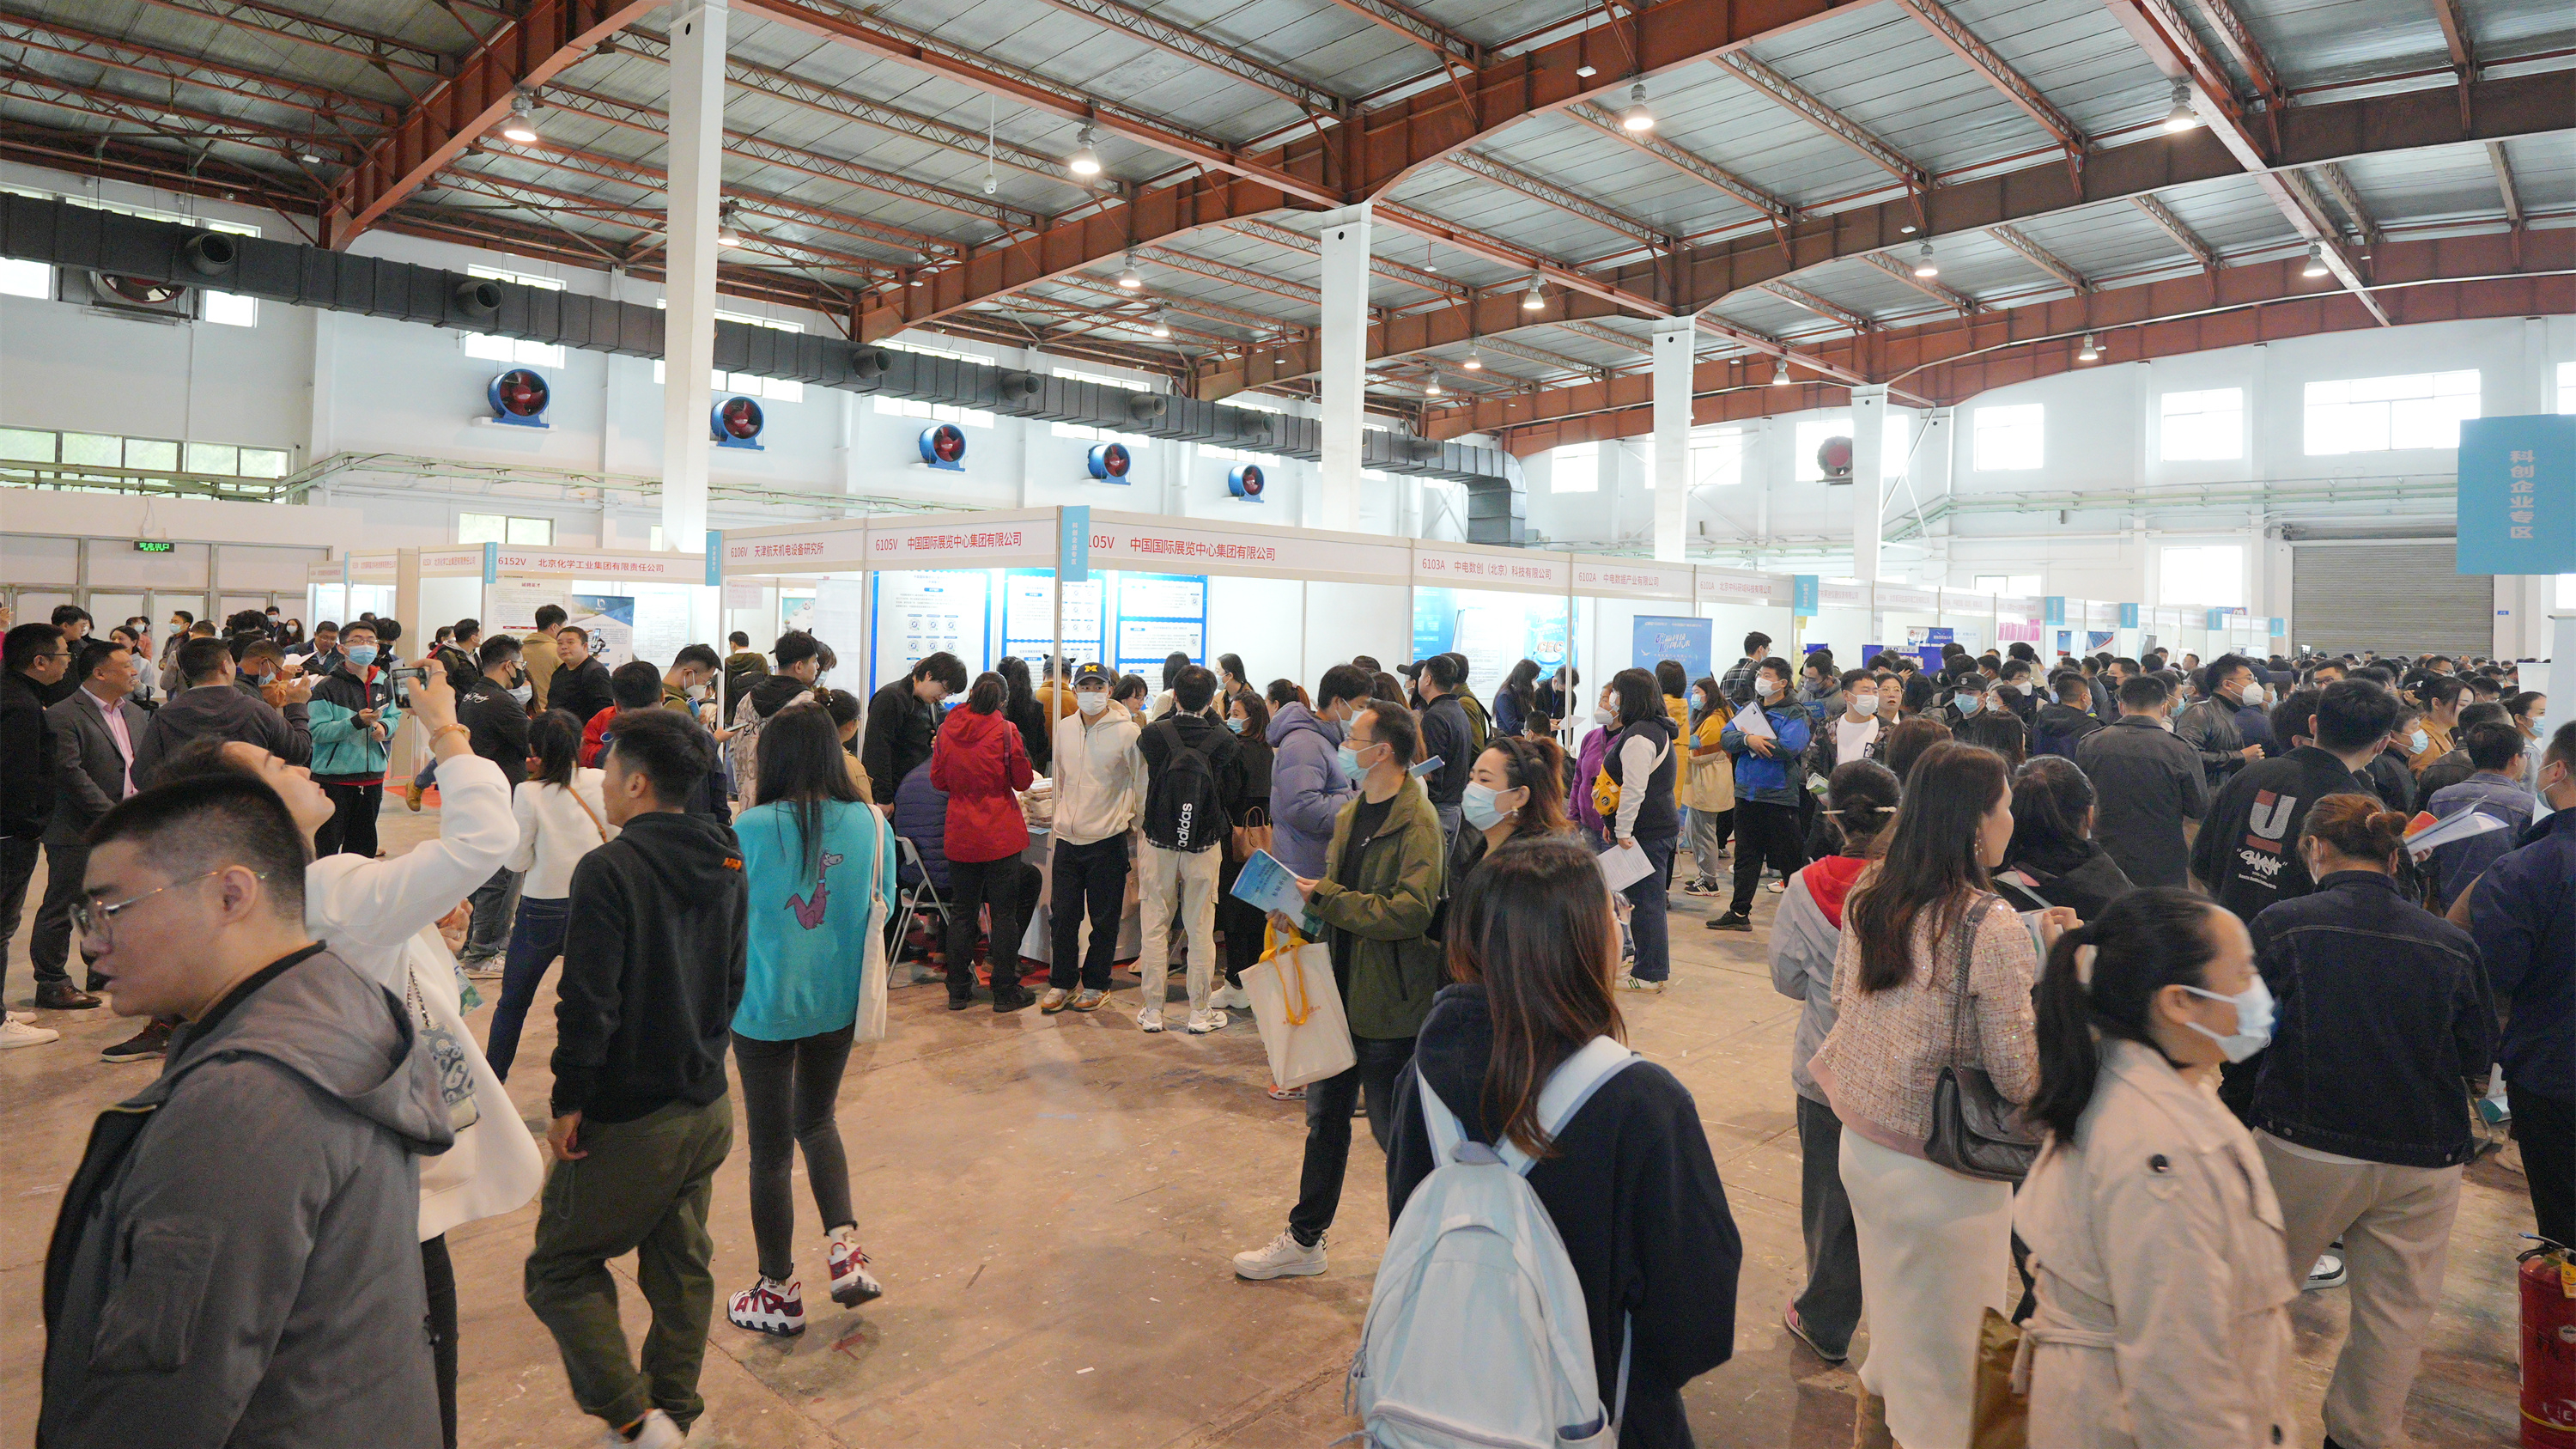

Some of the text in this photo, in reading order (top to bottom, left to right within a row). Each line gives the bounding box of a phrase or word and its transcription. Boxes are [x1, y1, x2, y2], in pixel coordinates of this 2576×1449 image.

[2510, 449, 2535, 539] 科创企业专区
[731, 542, 824, 557] 6106V 天津航天机电设备研究所
[875, 532, 1022, 551] 6105V 中国国际展览中心集团有限公司
[1089, 534, 1276, 561] 105V 中国国际展览中心集团有限公司
[498, 557, 665, 573] 6152V 北京化学工业集团有限责任公司
[1422, 558, 1446, 570] 6103A
[1578, 571, 1660, 587] 6102A 中电数据产业有限公司
[1537, 641, 1564, 653] CEC
[1176, 802, 1193, 848] adidas
